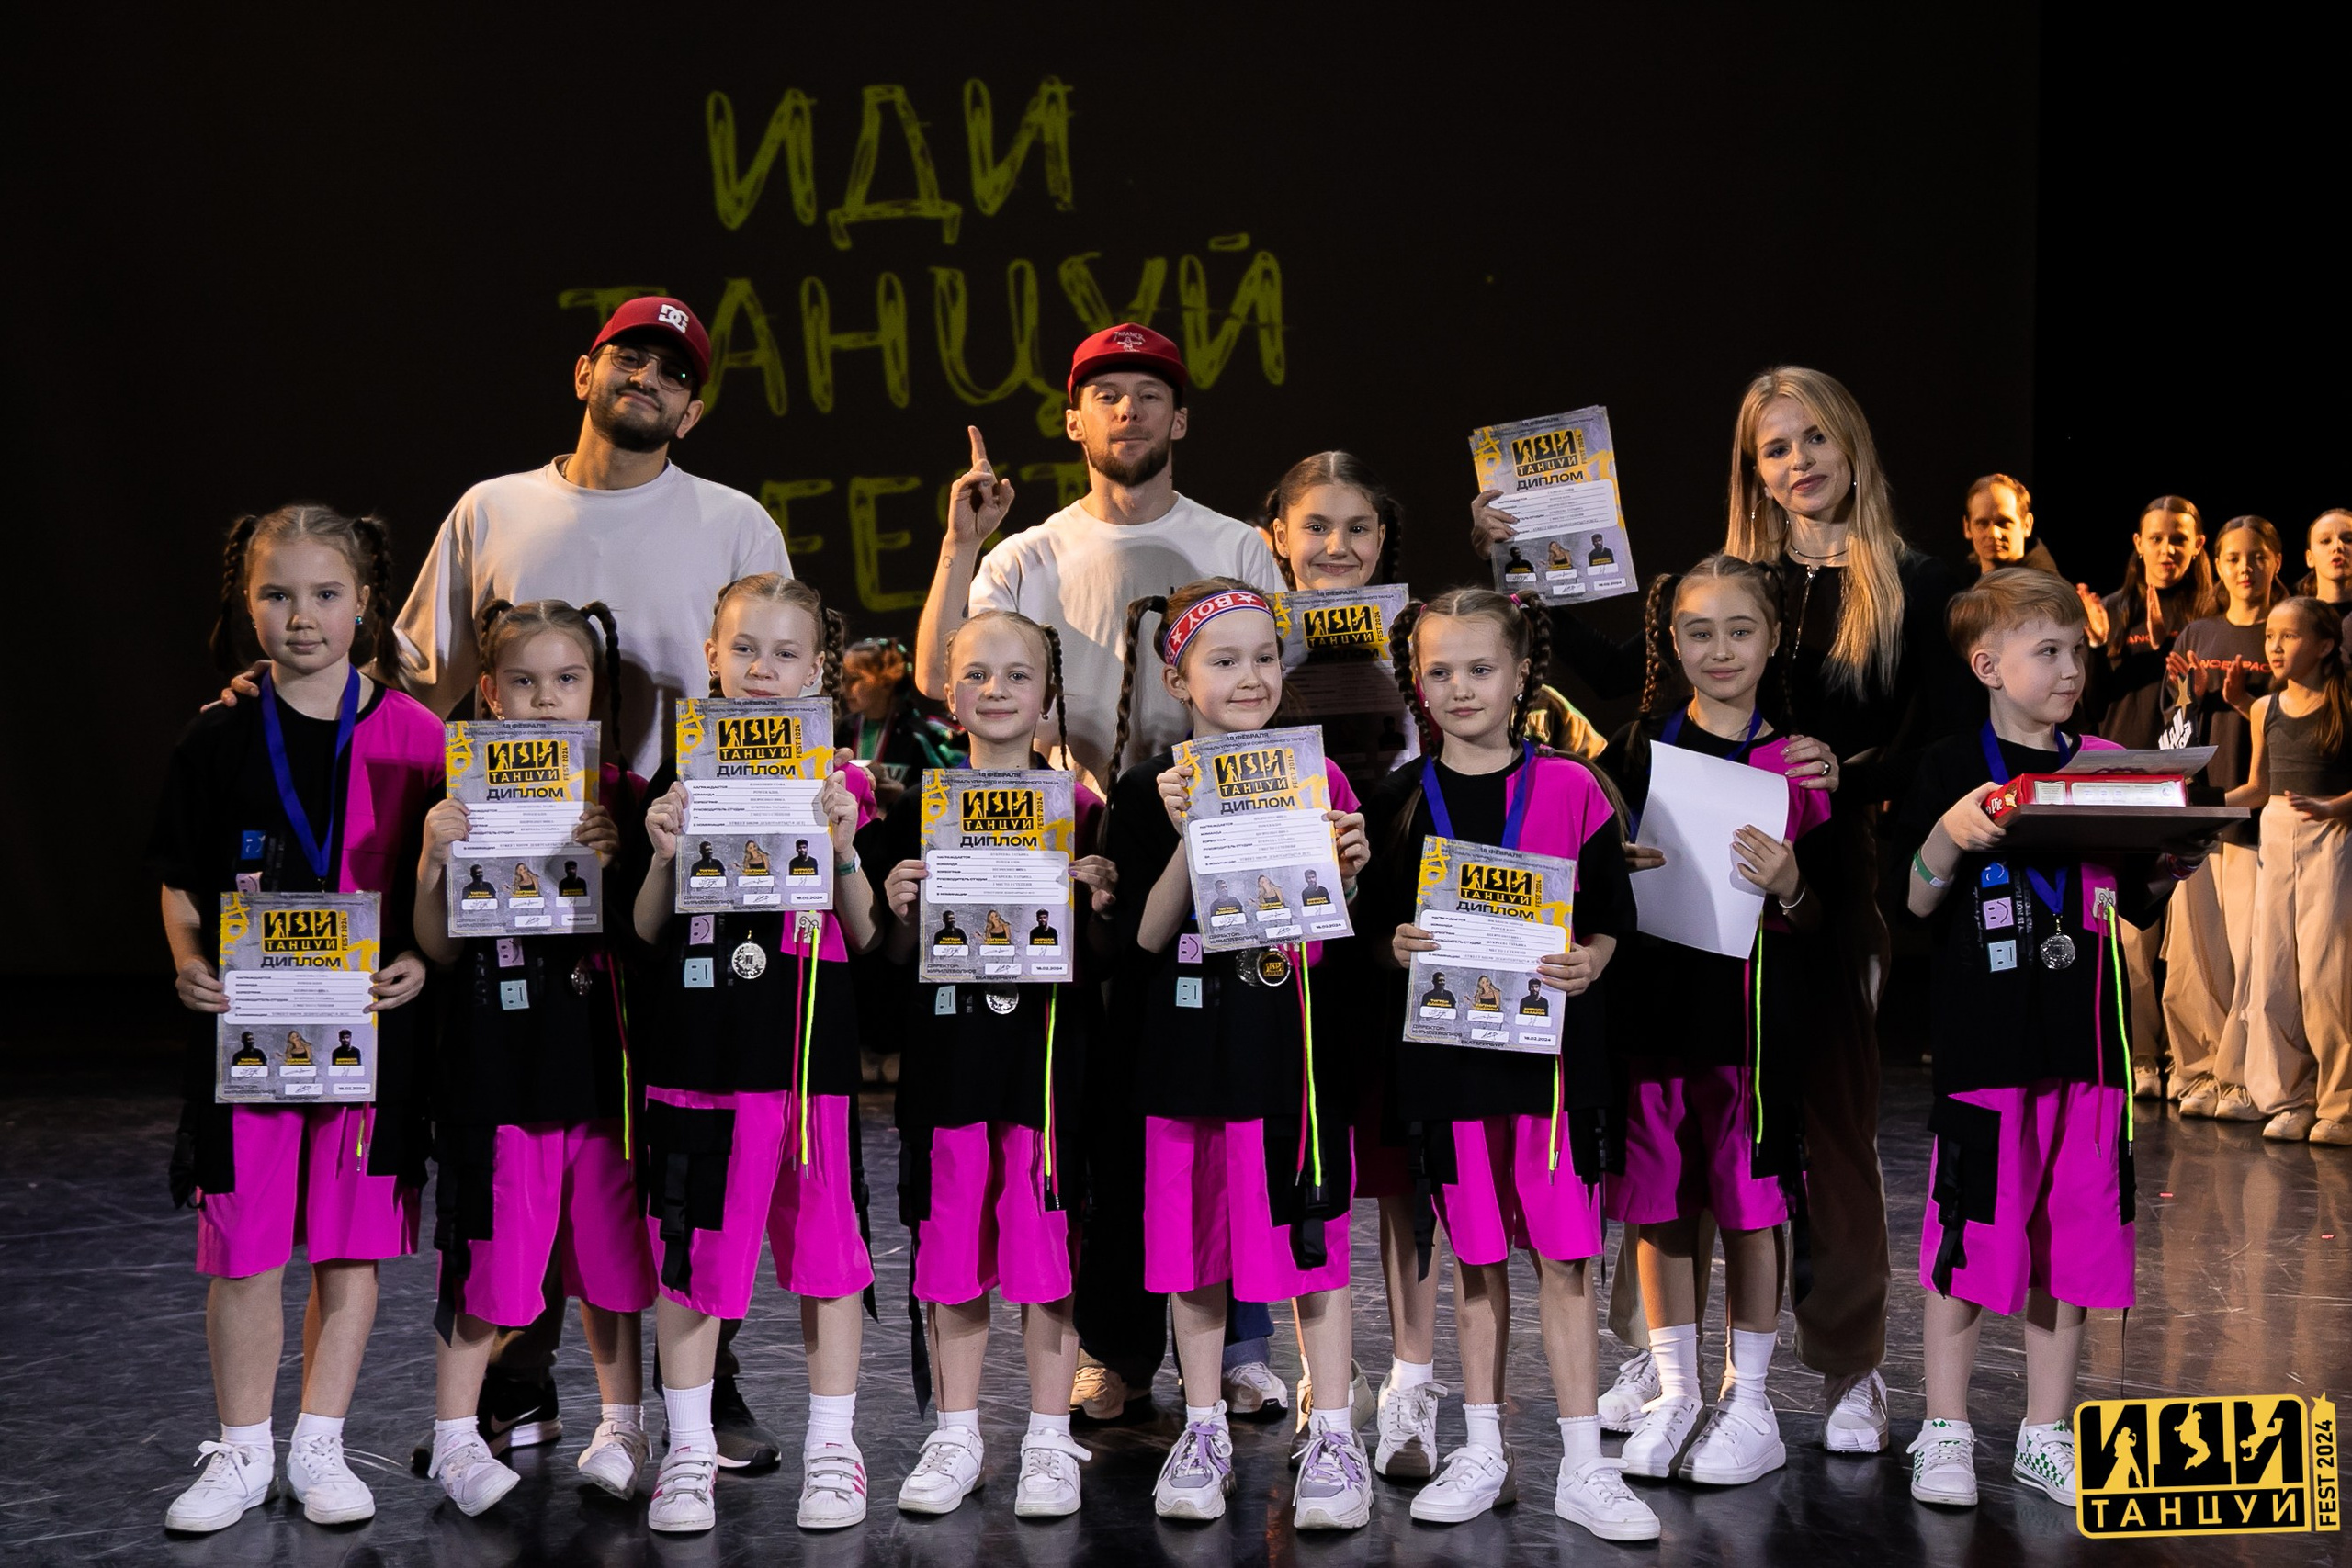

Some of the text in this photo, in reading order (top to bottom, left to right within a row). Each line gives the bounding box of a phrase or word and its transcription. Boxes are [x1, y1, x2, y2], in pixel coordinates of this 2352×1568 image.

[707, 75, 1076, 249] ИДИ
[658, 304, 689, 333] DC
[1511, 429, 1578, 466] ИДИ
[1516, 470, 1584, 492] ДИПЛОМ
[760, 460, 1088, 612] FET
[1187, 594, 1235, 630] BOY
[1303, 605, 1373, 637] ИДИ
[718, 717, 792, 748] ИДИ
[487, 740, 560, 771] ИДИ
[1214, 749, 1287, 784] ИДИ
[716, 764, 797, 778] ДИПЛОМ
[485, 786, 564, 801] ДИПЛОМ
[962, 790, 1034, 818] ИДИ
[1219, 795, 1295, 816] ДИПЛОМ
[1991, 797, 2003, 814] Pie
[959, 836, 1037, 848] ДИПЛОМ
[1460, 863, 1532, 896] ИДИ
[263, 910, 338, 939] ИДИ
[1455, 900, 1535, 920] ДИПЛОМ
[260, 956, 342, 969] ДИПЛОМ
